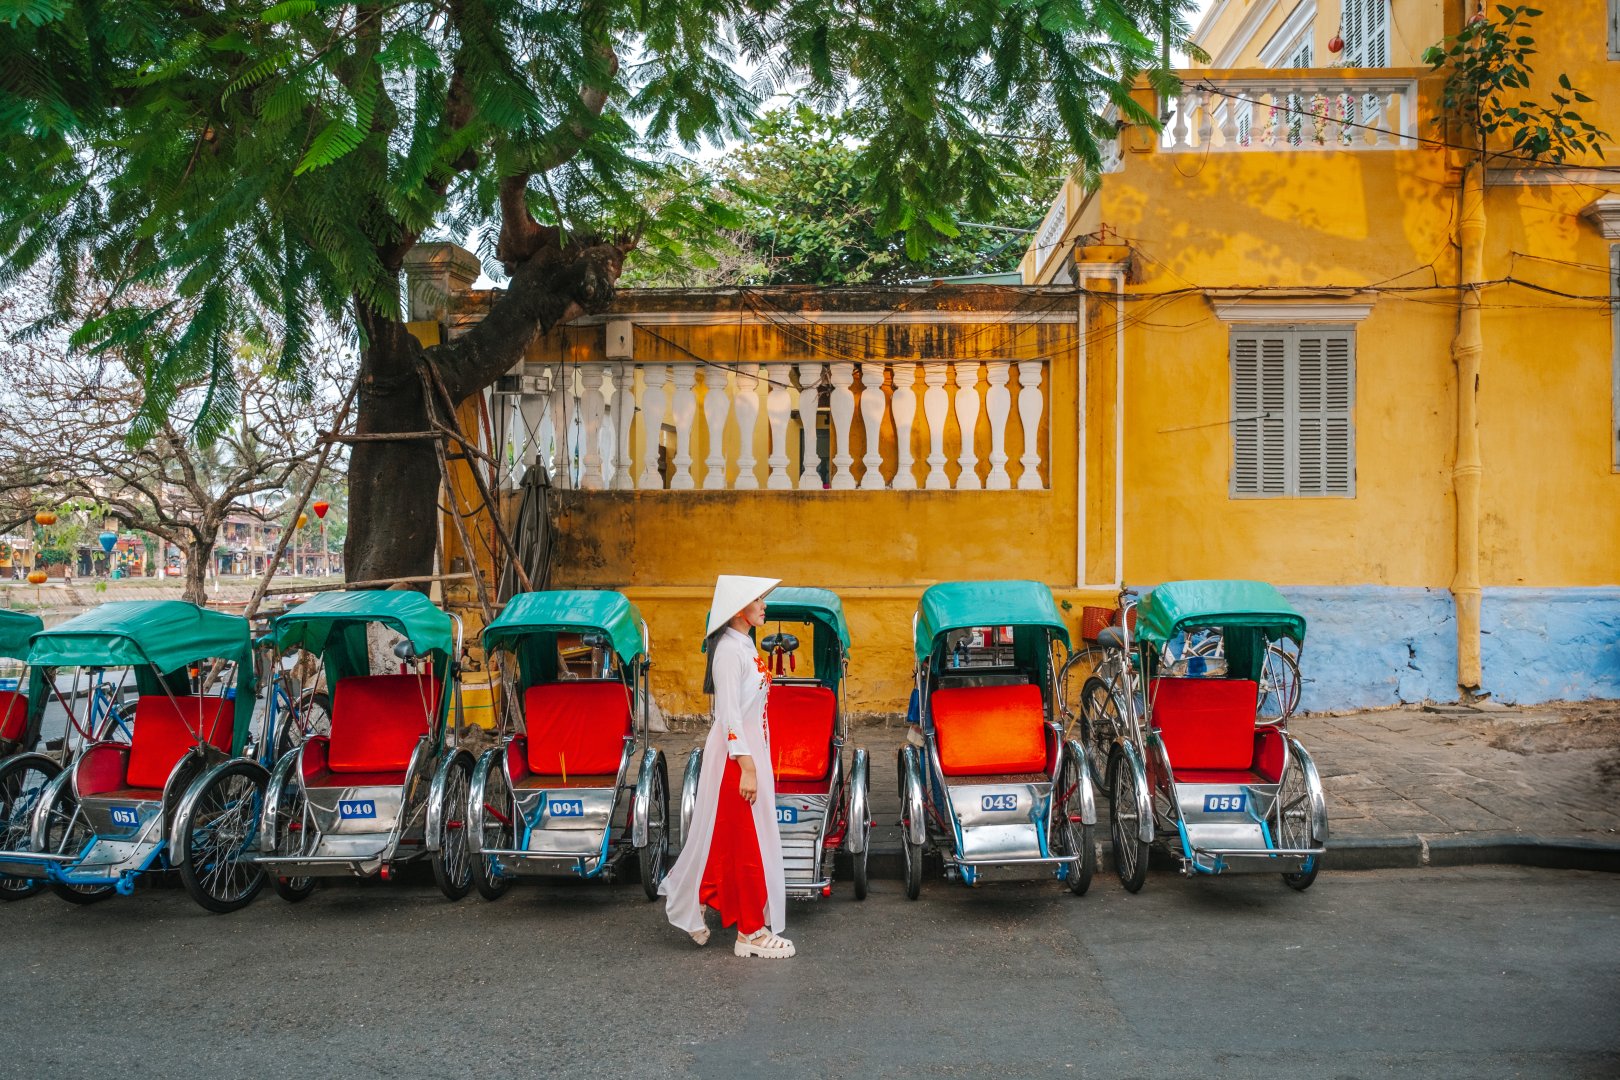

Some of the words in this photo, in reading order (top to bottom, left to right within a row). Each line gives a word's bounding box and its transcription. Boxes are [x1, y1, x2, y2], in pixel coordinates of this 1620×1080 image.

[342, 803, 373, 815] 040
[552, 802, 580, 815] 091
[982, 795, 1017, 810] 043
[1209, 797, 1241, 810] 059
[113, 810, 138, 824] 051
[776, 809, 792, 822] 06
